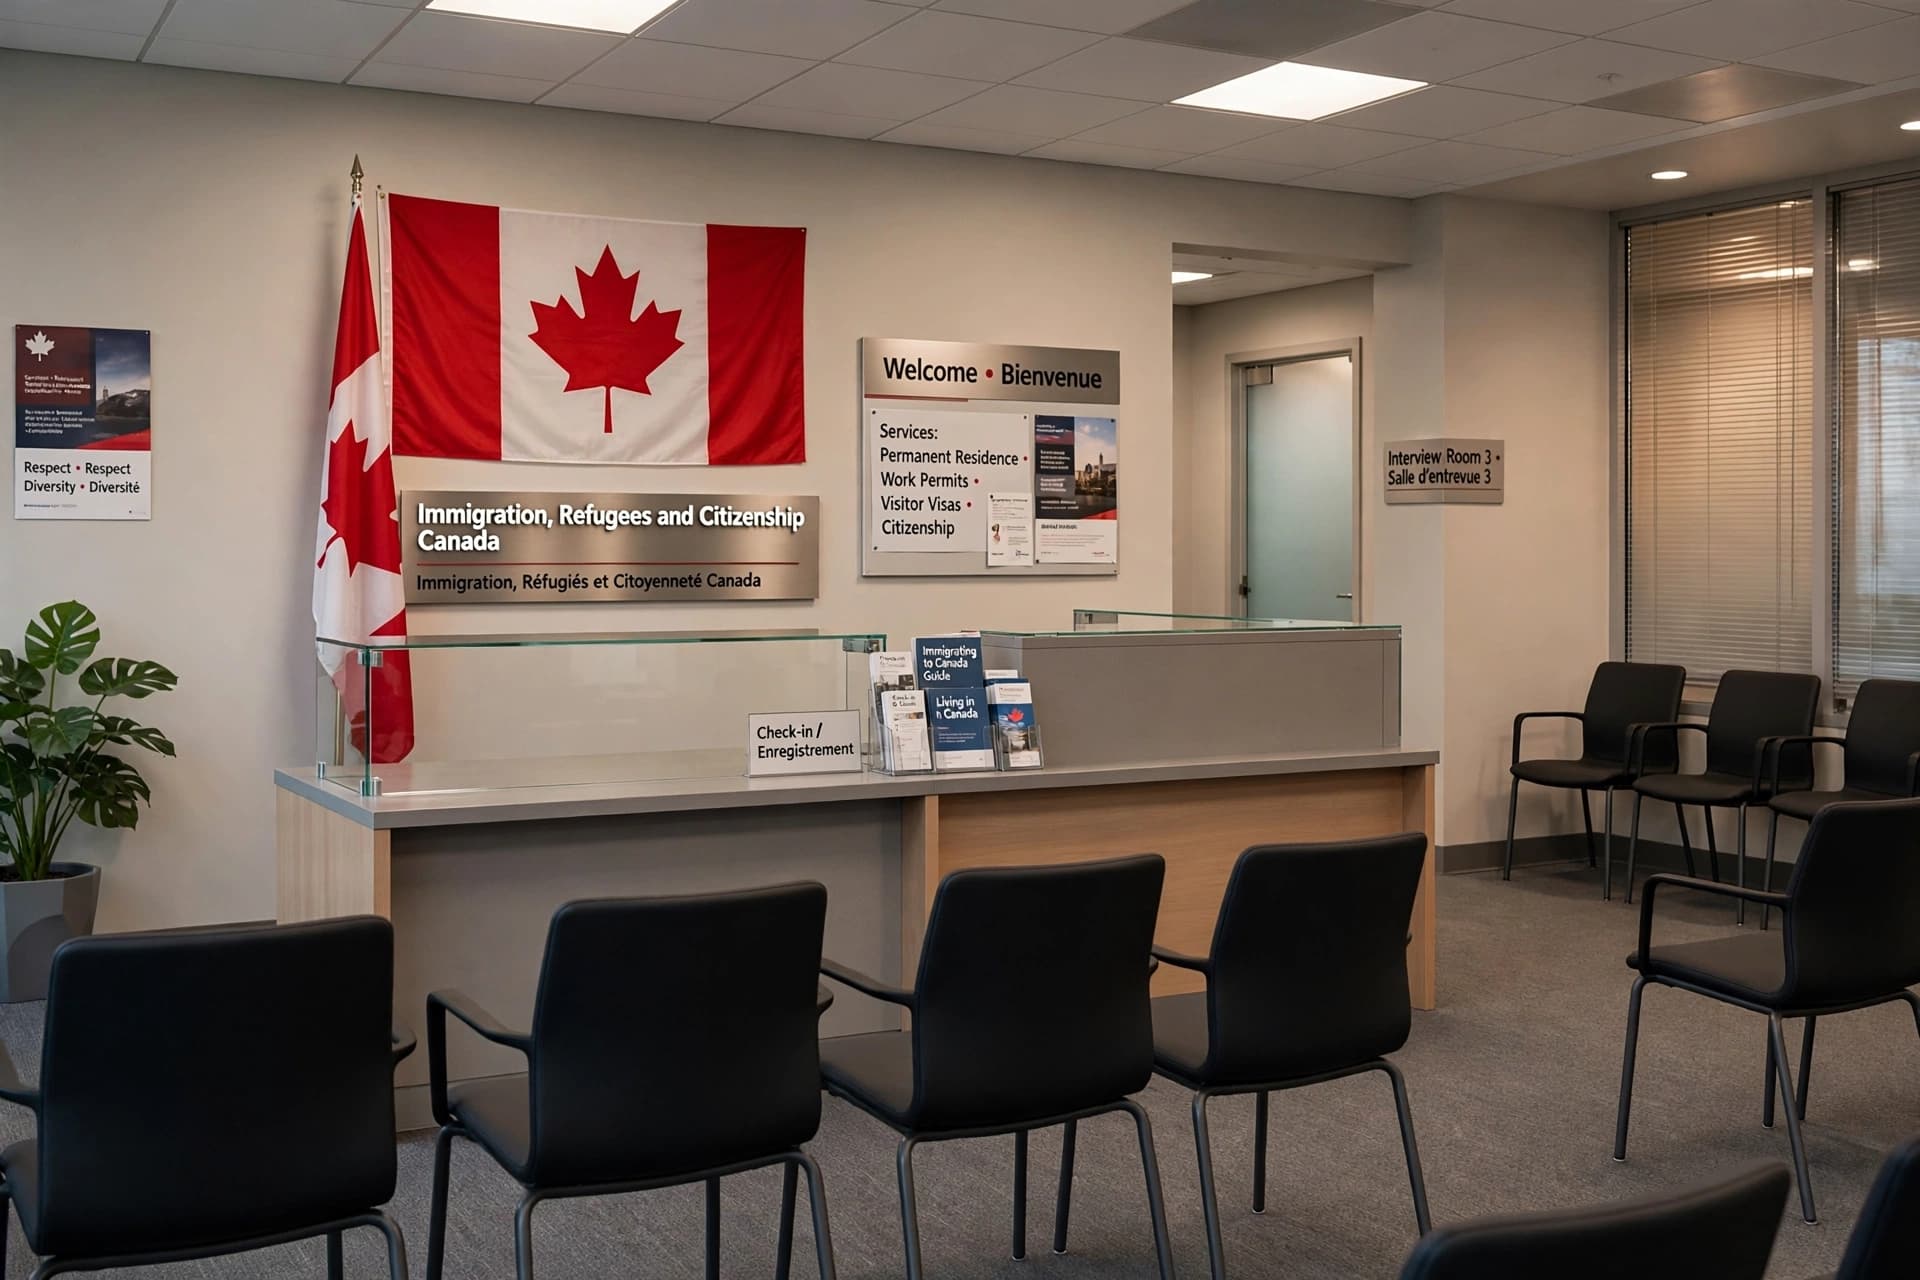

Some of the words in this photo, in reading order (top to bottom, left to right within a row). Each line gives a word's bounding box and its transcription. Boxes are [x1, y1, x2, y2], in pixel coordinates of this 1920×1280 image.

[883, 357, 977, 383] Welcome
[1002, 363, 1102, 388] Bienvenue
[880, 424, 938, 439] Services:
[880, 448, 951, 464] Permanent
[956, 450, 1018, 465] Residence
[1389, 449, 1441, 465] Interview
[1447, 449, 1480, 464] Room
[1485, 450, 1491, 464] 3
[25, 462, 71, 475] Respect
[86, 463, 131, 477] Respect
[1388, 469, 1414, 485] Salle
[1419, 468, 1480, 484] d'entrevue
[1484, 469, 1491, 484] 3
[25, 480, 75, 495] Diversity
[90, 481, 140, 493] Diversité
[881, 472, 915, 487] Work
[921, 473, 968, 488] Permits
[881, 496, 923, 511] Visitor
[928, 496, 961, 512] Visas
[418, 503, 553, 529] Immigration,
[560, 504, 652, 531] Refugees
[658, 505, 693, 527] and
[699, 506, 805, 532] Citizenship
[882, 519, 955, 538] Citizenship
[418, 529, 500, 552] Canada
[417, 574, 517, 593] Immigration,
[523, 574, 588, 592] Réfugiés
[594, 575, 608, 590] et
[614, 573, 701, 592] Citoyenneté
[707, 573, 761, 589] Canada
[923, 645, 976, 658] Immigrating
[924, 659, 933, 668] to
[935, 658, 968, 668] Canada
[924, 670, 950, 680] Guide
[936, 696, 964, 709] Living
[967, 696, 975, 706] in
[944, 709, 978, 719] Canada
[757, 724, 812, 739] Check-in
[816, 722, 822, 738] /
[758, 742, 854, 761] Enregistrement
